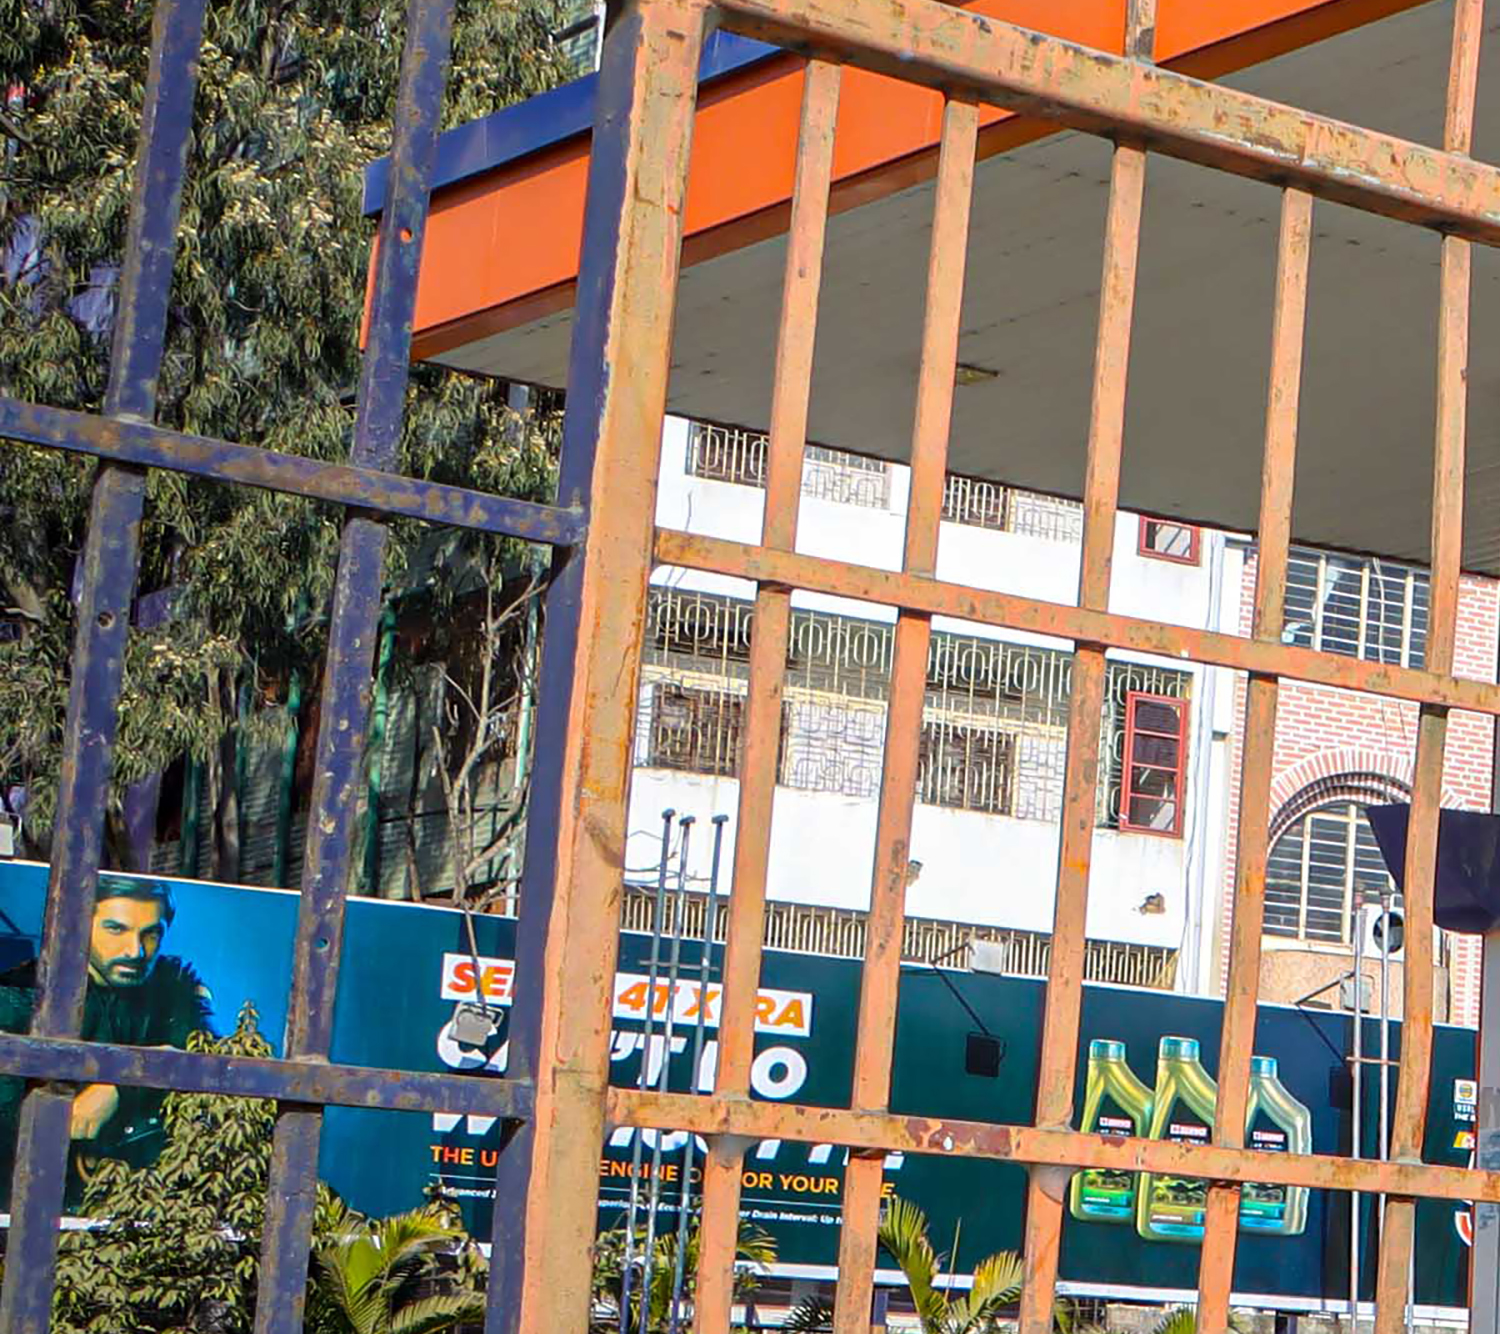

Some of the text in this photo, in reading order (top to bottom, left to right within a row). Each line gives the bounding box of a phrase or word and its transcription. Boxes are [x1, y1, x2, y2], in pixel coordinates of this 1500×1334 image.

[684, 988, 805, 1029] XRA
[430, 1146, 475, 1165] THE
[741, 1171, 773, 1189] OR
[780, 1174, 838, 1195] YOUR
